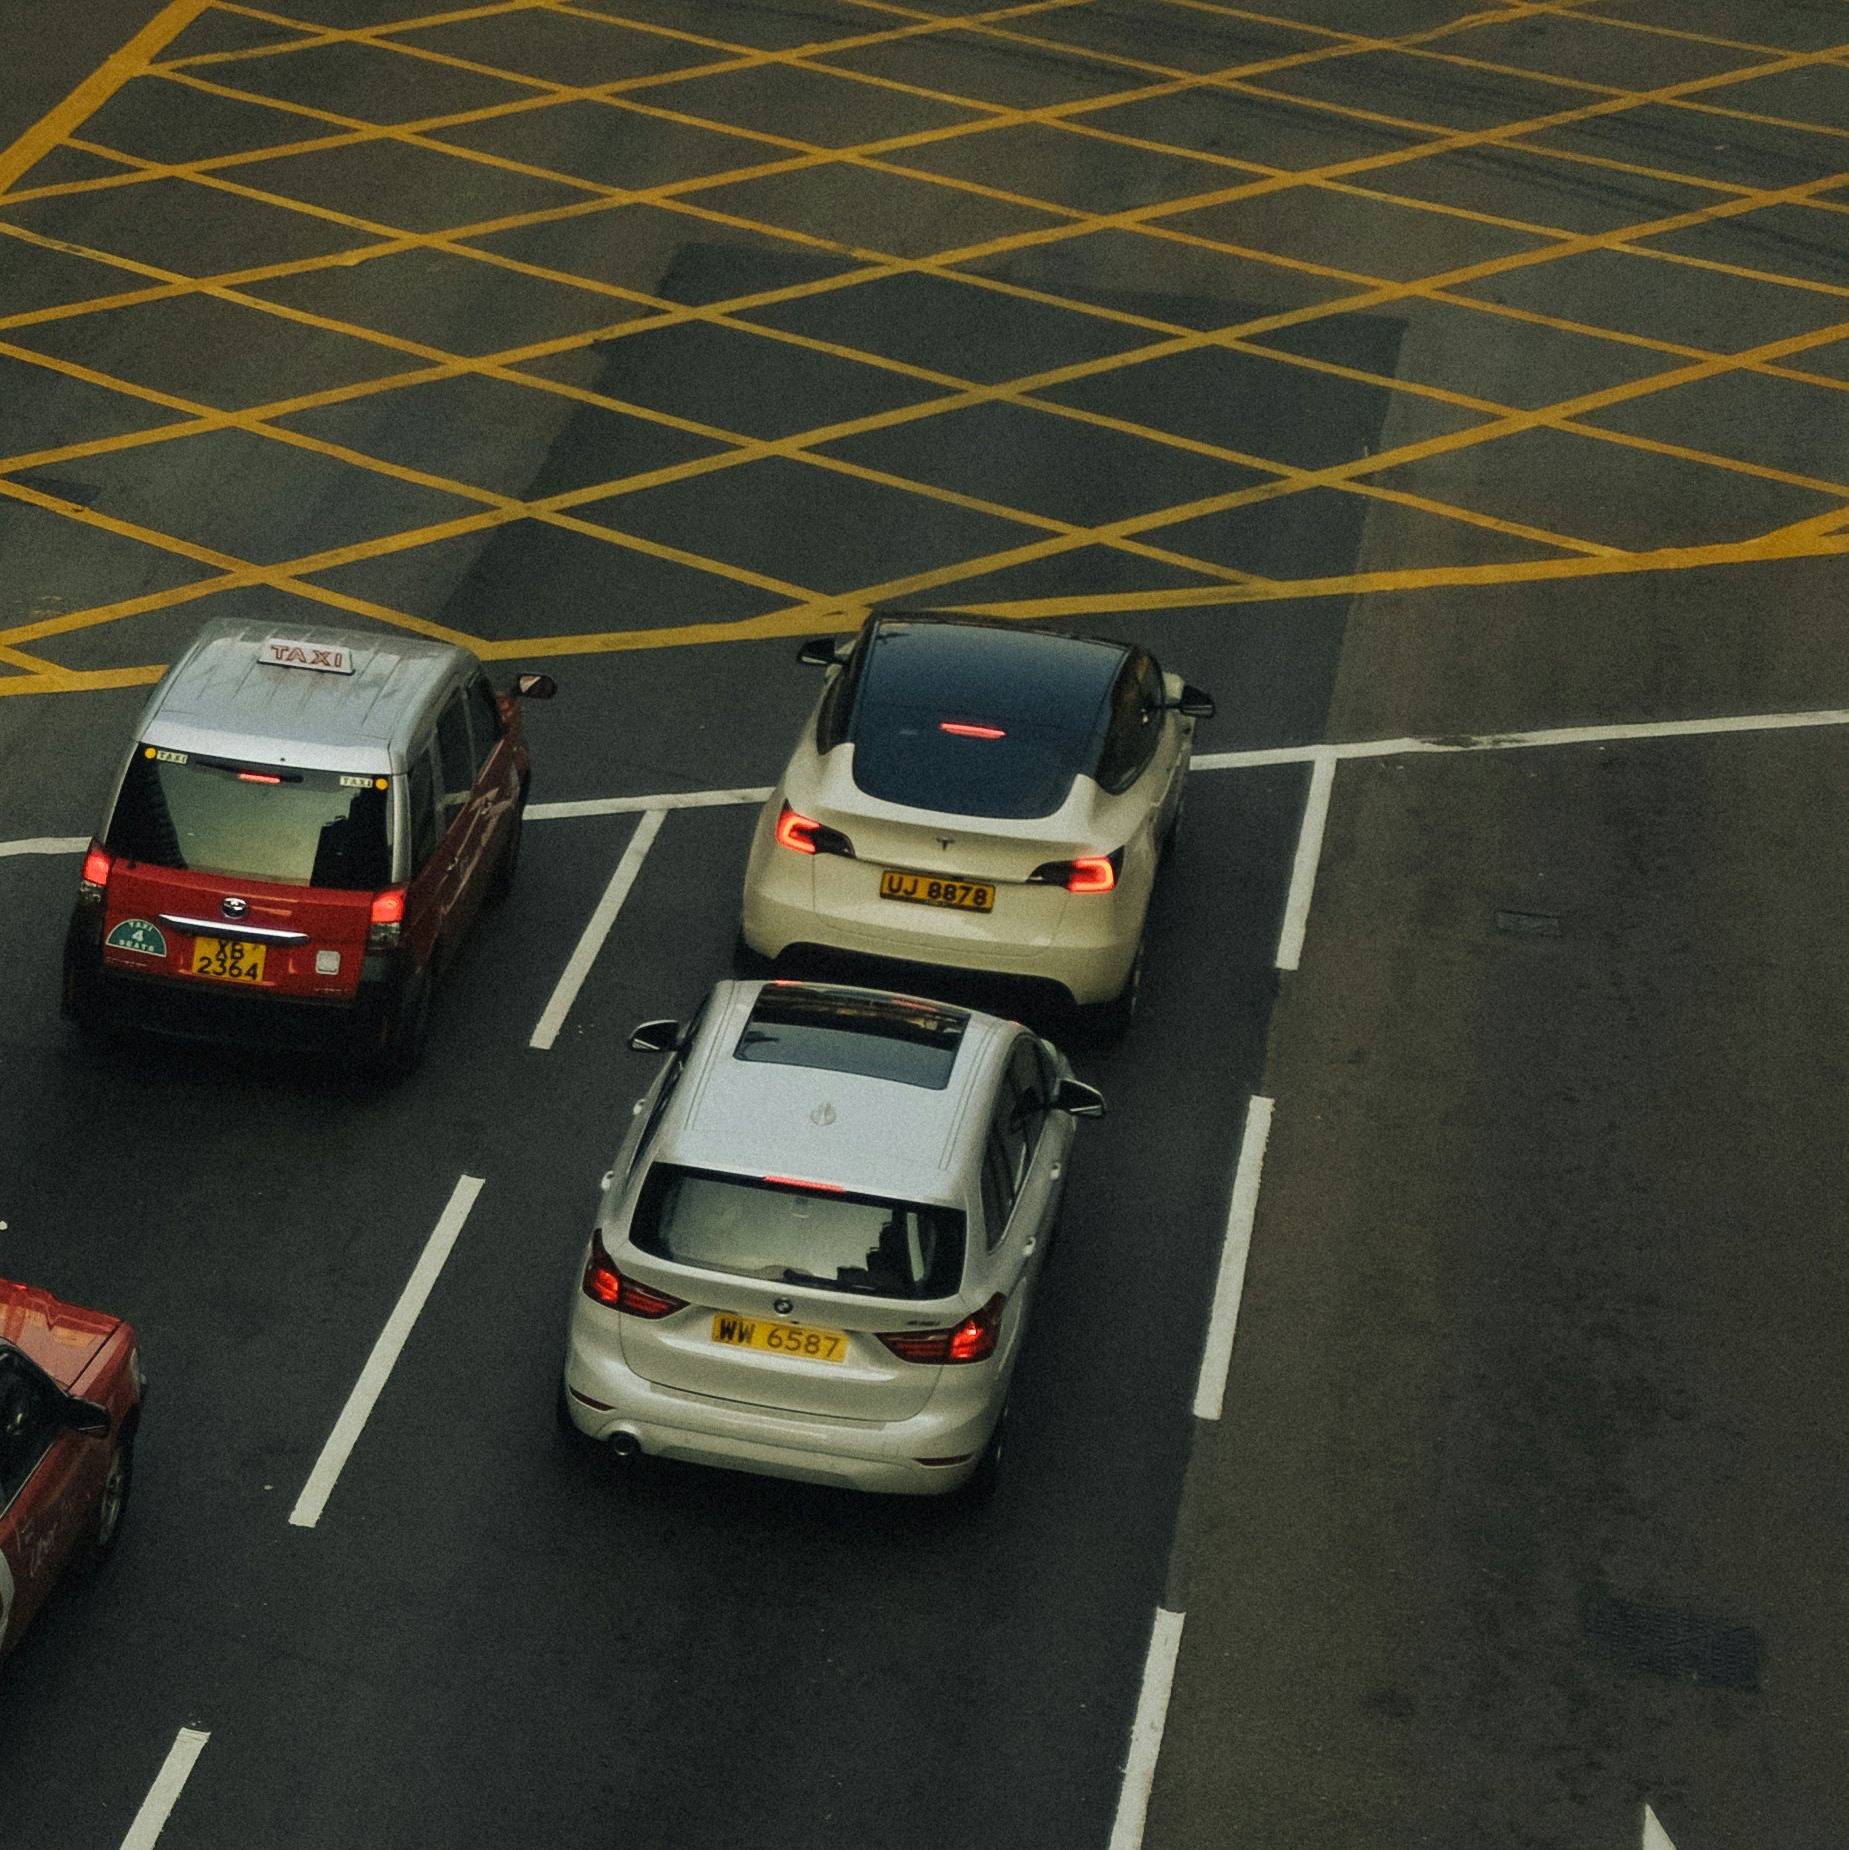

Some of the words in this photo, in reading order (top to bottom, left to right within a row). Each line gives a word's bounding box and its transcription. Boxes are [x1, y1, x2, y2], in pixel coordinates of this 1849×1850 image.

[270, 644, 344, 669] TAXI
[886, 873, 918, 898] UJ
[926, 878, 990, 909] 8878
[127, 920, 154, 933] TAXI
[130, 929, 145, 943] 4
[214, 938, 245, 962] XB
[197, 956, 259, 982] 2364
[719, 1318, 756, 1344] WW
[767, 1327, 840, 1358] 6587
